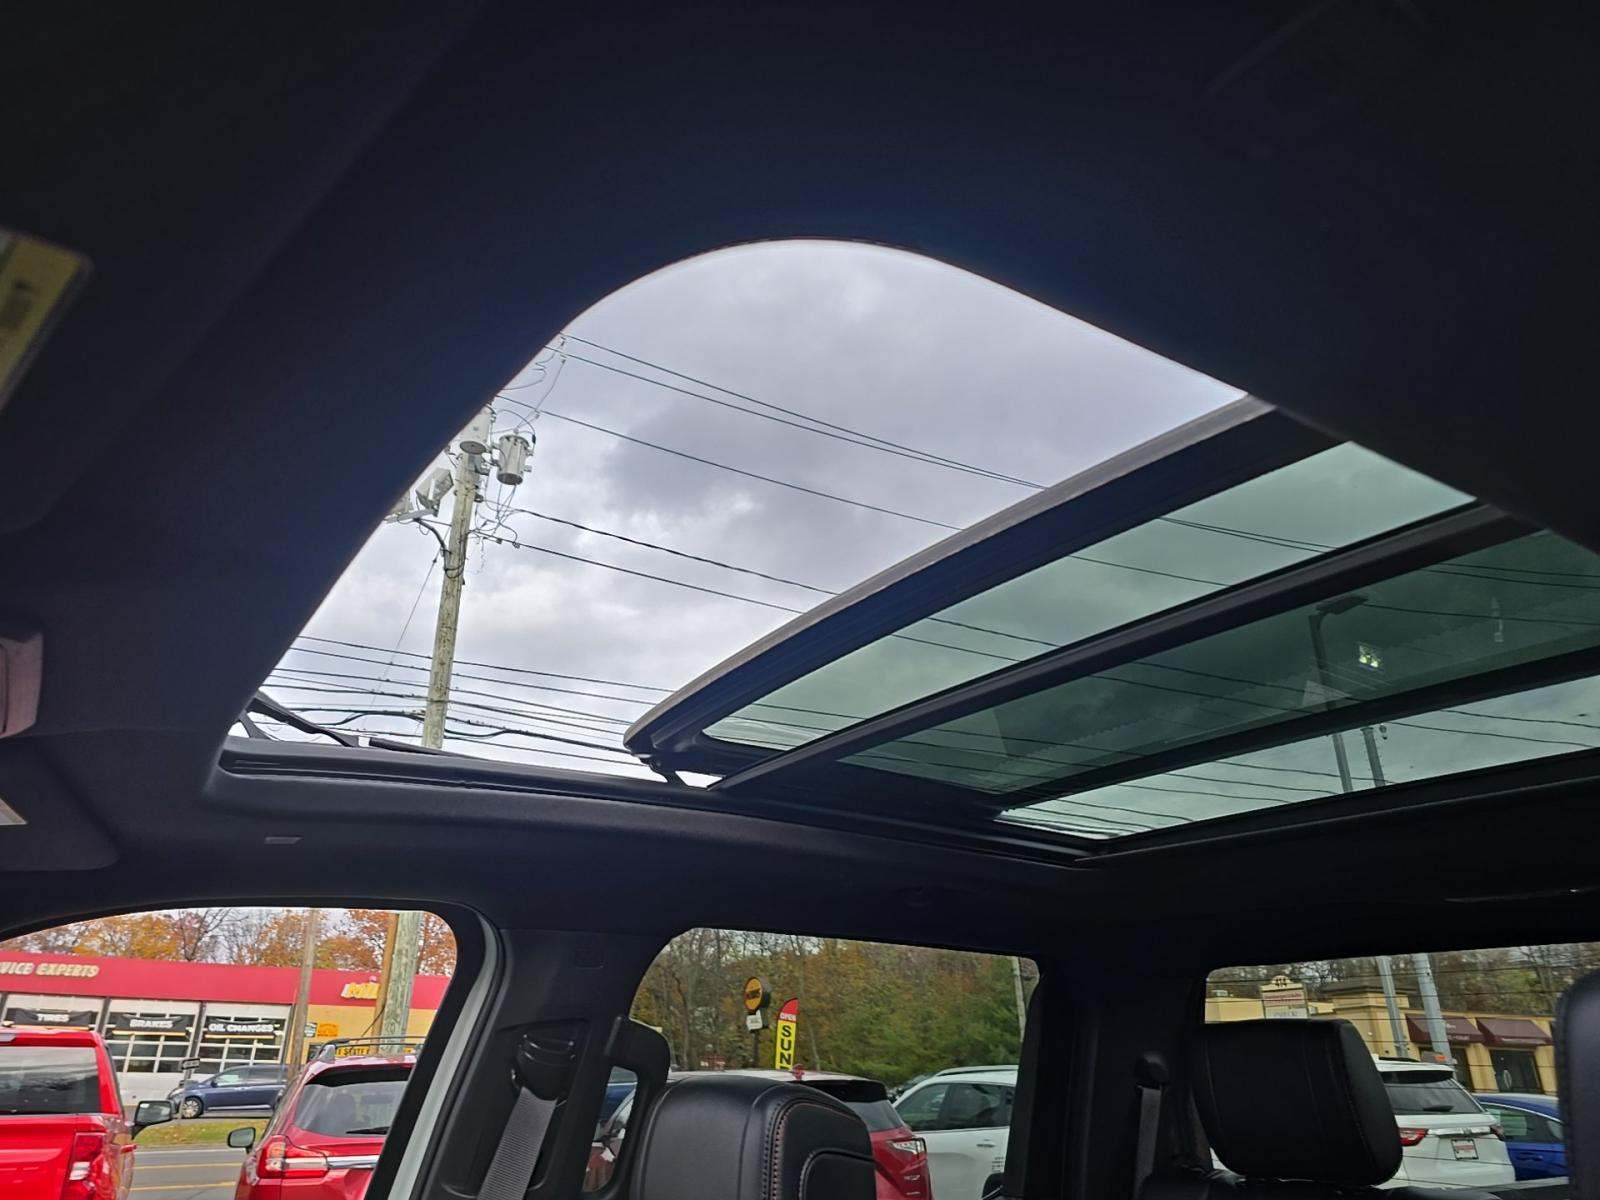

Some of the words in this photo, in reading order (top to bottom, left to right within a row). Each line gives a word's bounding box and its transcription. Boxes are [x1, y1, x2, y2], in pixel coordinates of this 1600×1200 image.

[36, 963, 99, 977] EXPERTS
[37, 1013, 70, 1022] TIRES
[130, 1020, 173, 1029] BRAKES
[209, 1023, 225, 1032] OIL
[227, 1023, 274, 1032] CHANGES
